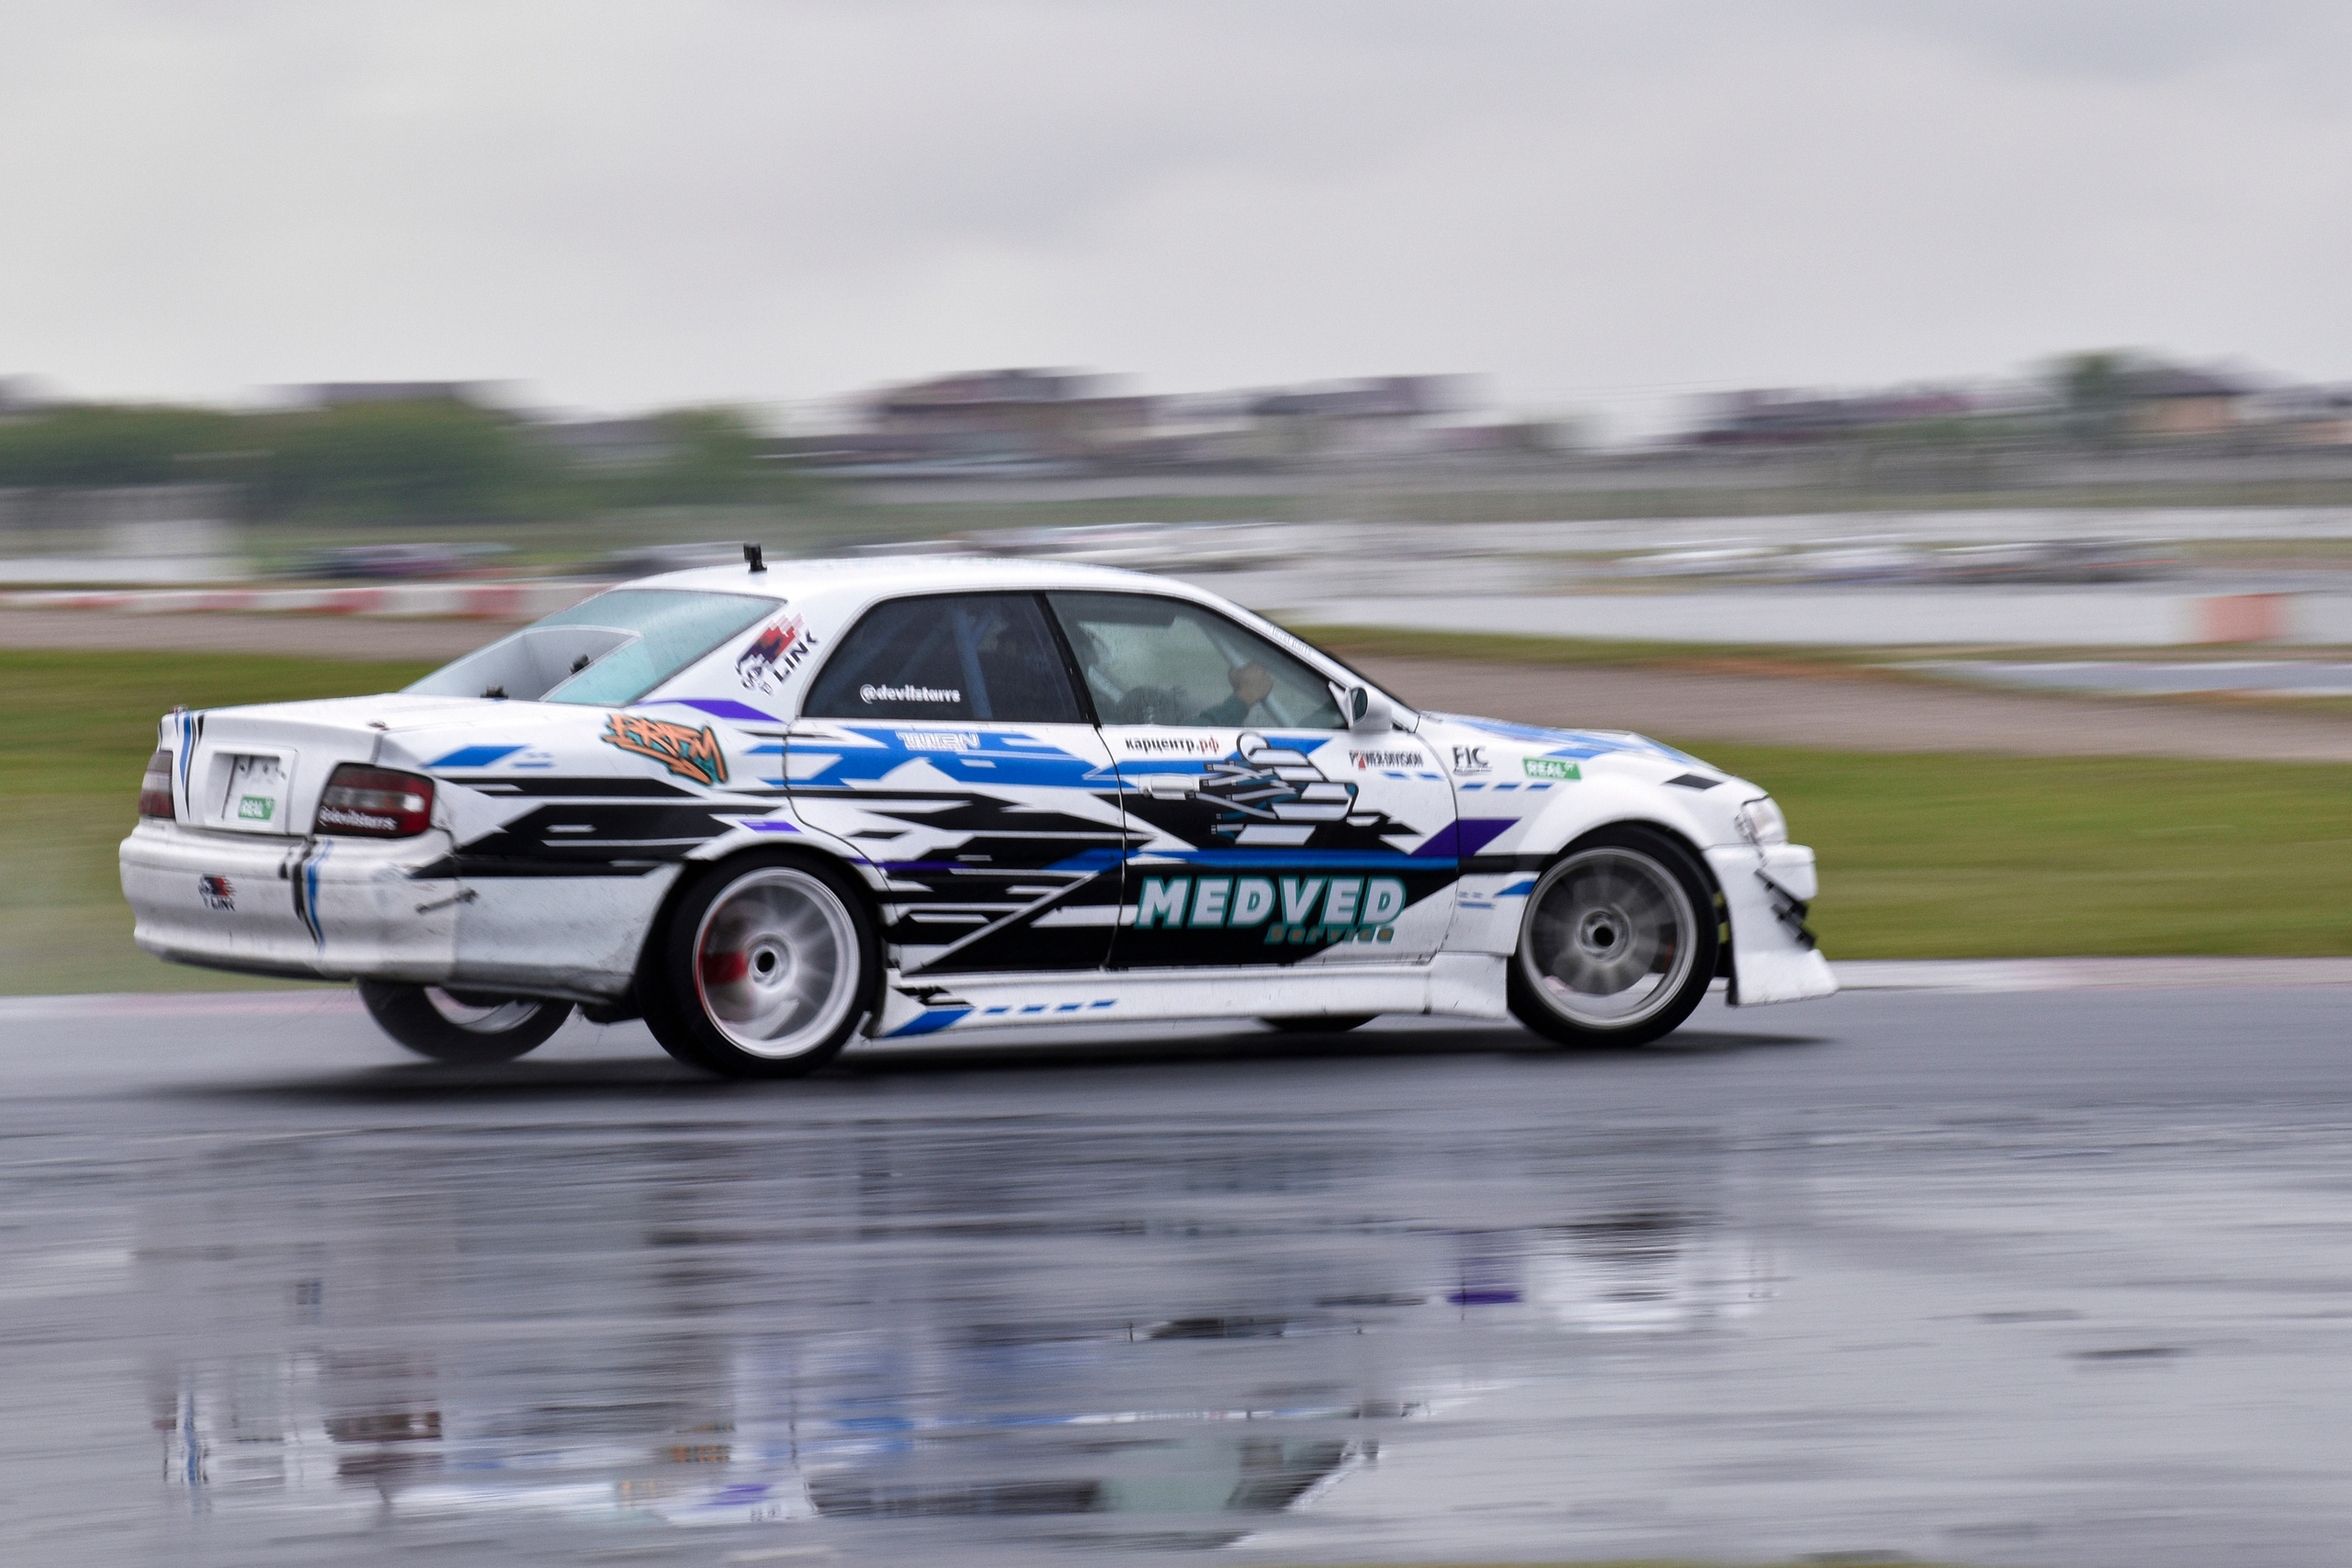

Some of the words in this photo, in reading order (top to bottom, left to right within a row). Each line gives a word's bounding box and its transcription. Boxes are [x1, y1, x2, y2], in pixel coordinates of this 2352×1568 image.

[1125, 736, 1220, 754] карцентр.рф
[1452, 745, 1489, 768] FIC
[1135, 876, 1407, 929] MEDVED
